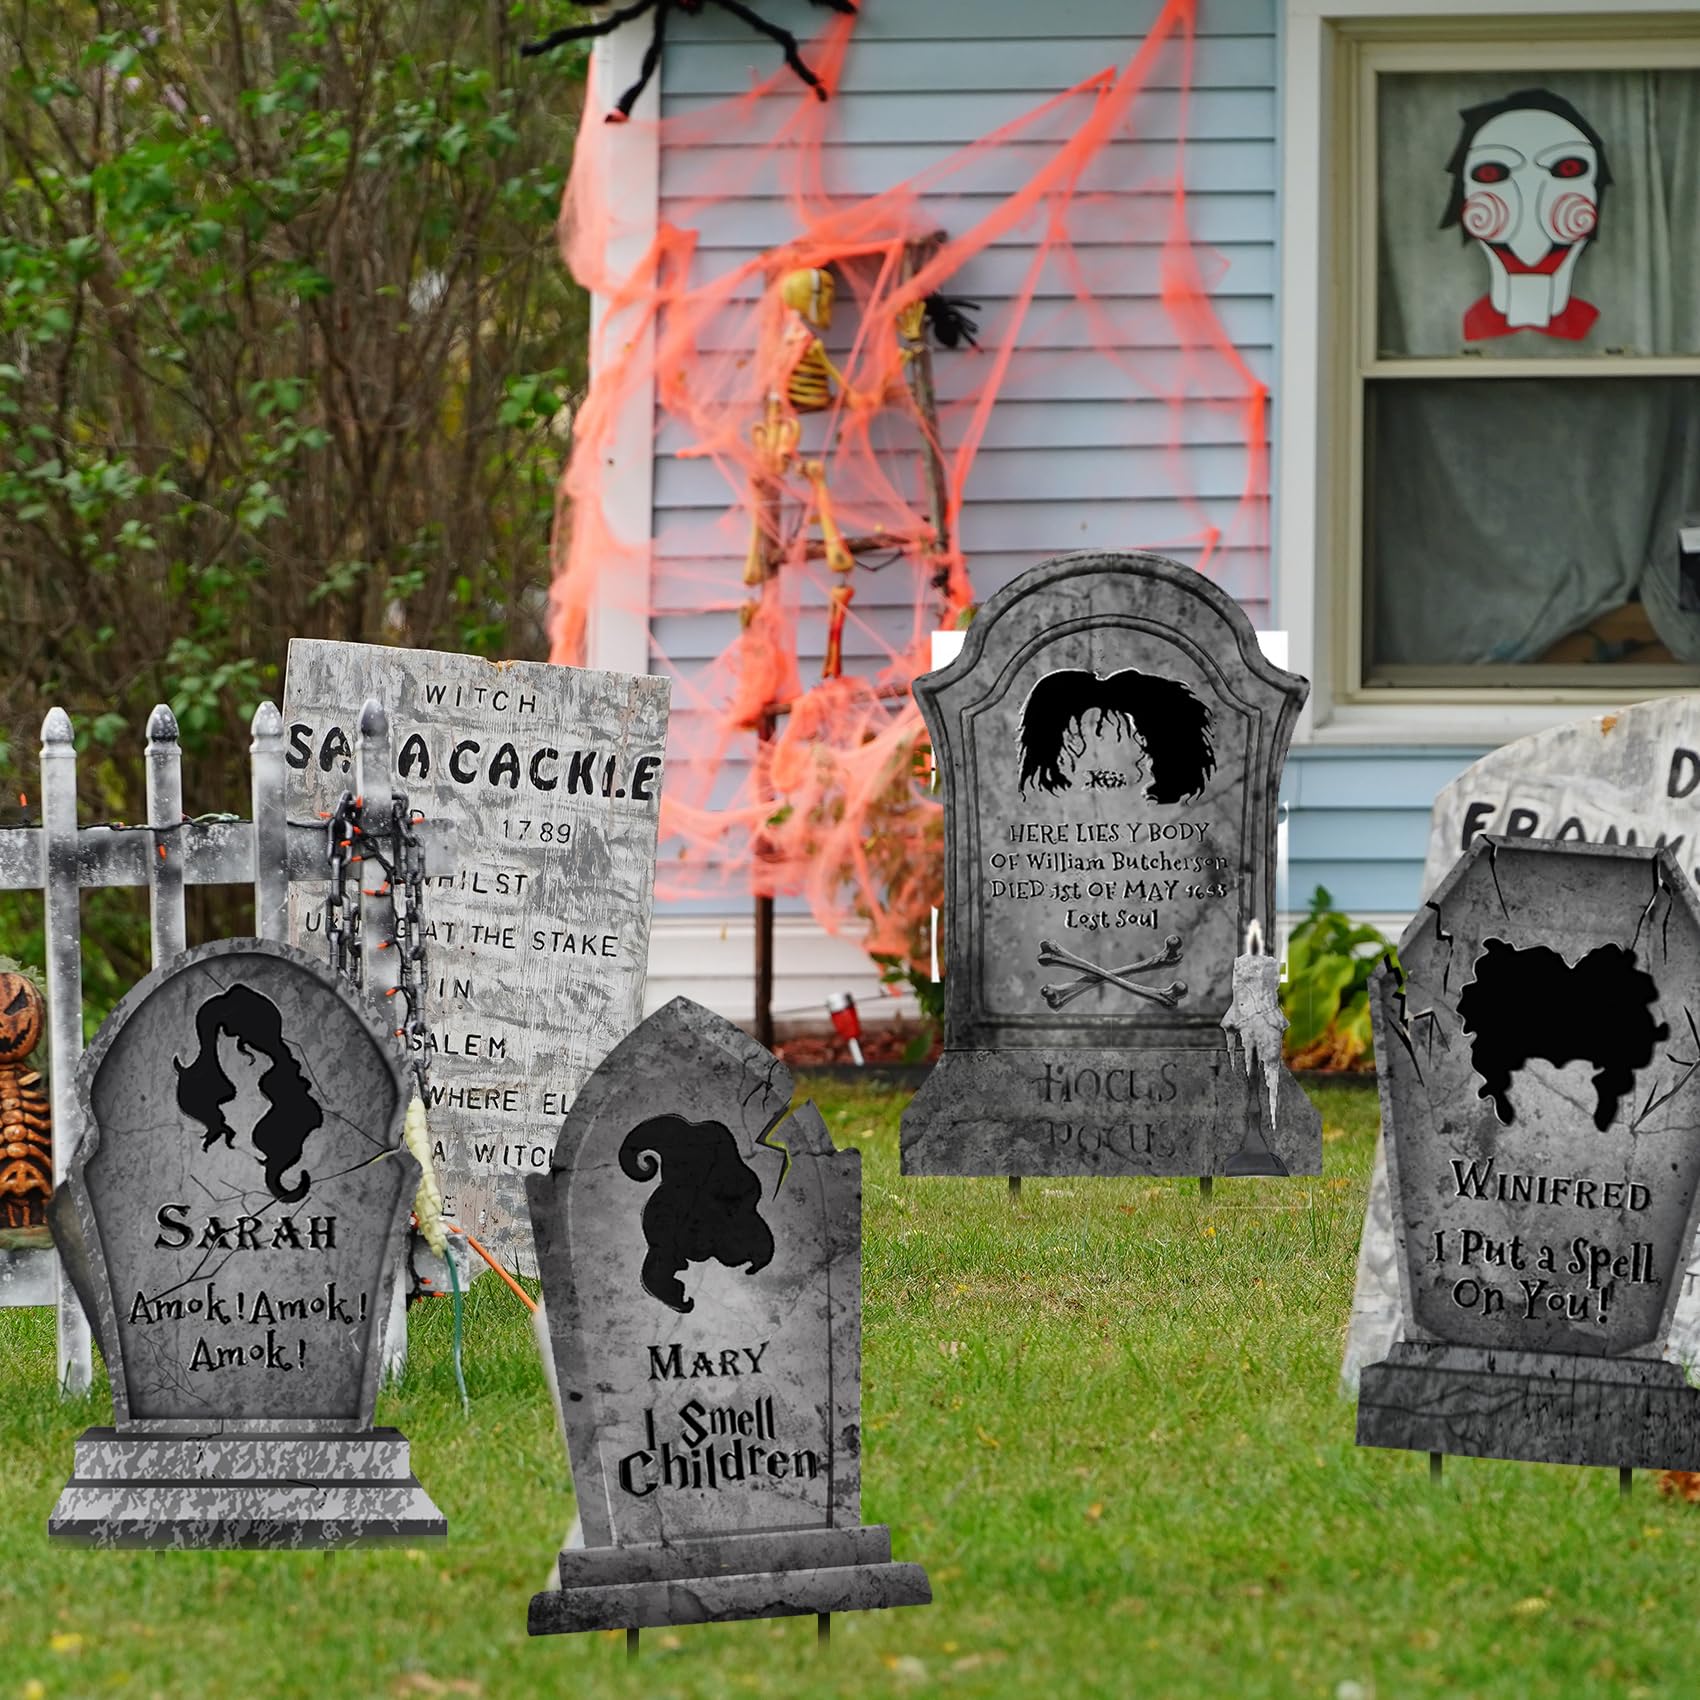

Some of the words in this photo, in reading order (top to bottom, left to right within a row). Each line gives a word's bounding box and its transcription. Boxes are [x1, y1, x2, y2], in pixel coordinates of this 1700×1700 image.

[425, 684, 536, 713] WITCH
[285, 723, 431, 779] SAA
[449, 740, 663, 801] CACKLE
[502, 819, 571, 844] 1789
[1010, 823, 1069, 845] HERE
[1075, 823, 1119, 843] LIES
[1126, 823, 1144, 843] Y
[1149, 822, 1210, 843] BODY
[1027, 853, 1105, 871] William
[1111, 852, 1229, 873] Butcherson
[424, 870, 528, 896] HILST
[991, 880, 1045, 899] DIED
[1087, 881, 1118, 900] OF
[1122, 879, 1180, 902] MAY
[1065, 909, 1110, 930] Lost
[1116, 909, 1158, 929] Soul
[472, 925, 516, 949] THE
[532, 930, 619, 958] STAKE
[439, 978, 471, 999] IN
[412, 1034, 507, 1059] SALEM
[1031, 1062, 1178, 1103] HOCUS
[427, 1086, 518, 1113] WHERE
[543, 1093, 571, 1116] EL
[475, 1144, 555, 1169] WITC
[154, 1203, 338, 1252] SARAH
[1434, 1230, 1446, 1263] I
[1459, 1229, 1526, 1271] Put
[1537, 1246, 1557, 1273] a
[1567, 1237, 1660, 1290] Spell
[1452, 1278, 1505, 1316] On
[1519, 1279, 1610, 1325] You!
[189, 1329, 307, 1373] Amok!
[647, 1340, 771, 1382] MARY
[643, 1408, 657, 1451] I
[678, 1394, 776, 1449] Smell
[618, 1438, 818, 1498] Children
